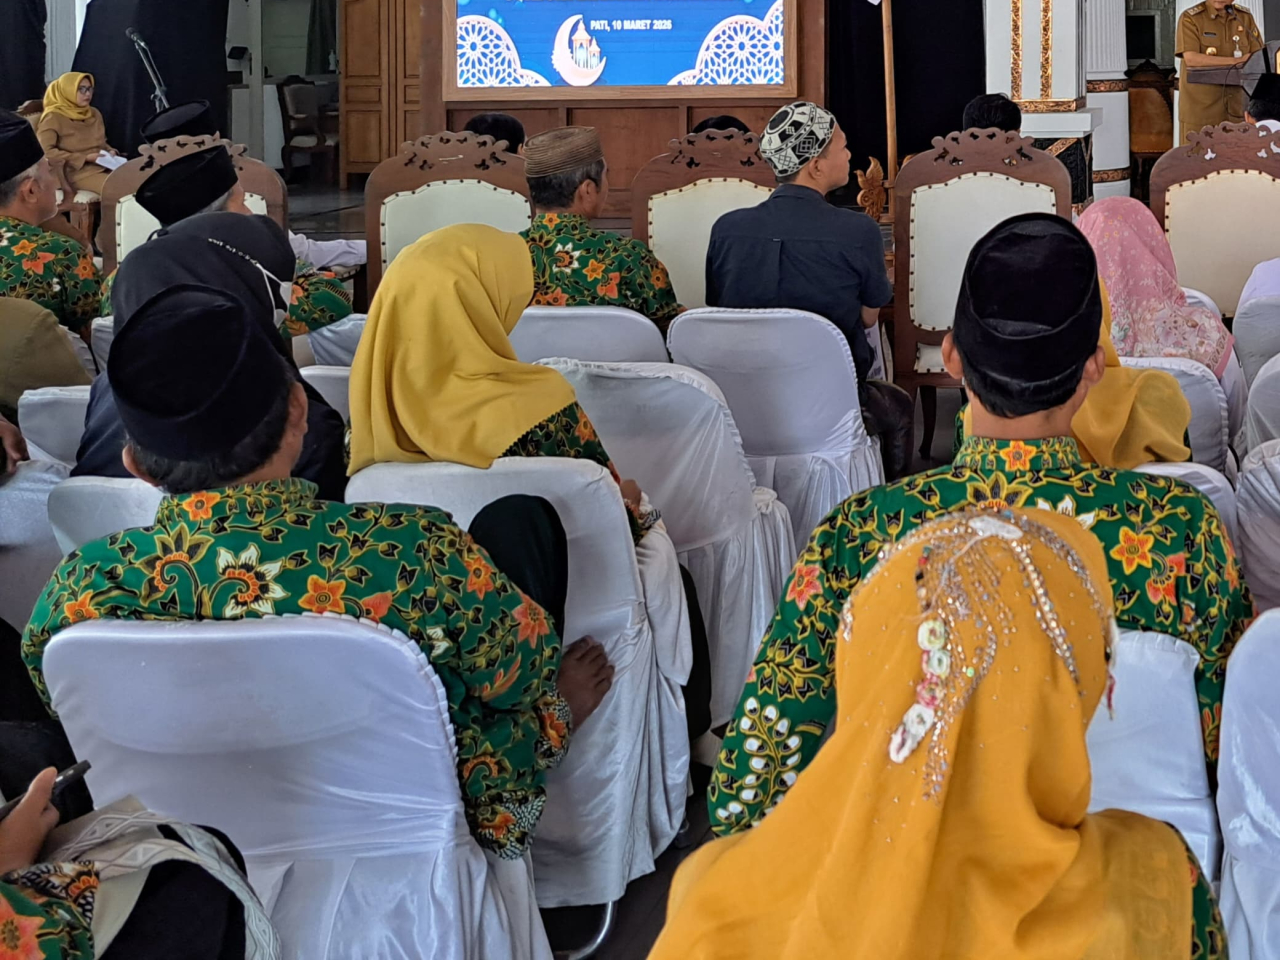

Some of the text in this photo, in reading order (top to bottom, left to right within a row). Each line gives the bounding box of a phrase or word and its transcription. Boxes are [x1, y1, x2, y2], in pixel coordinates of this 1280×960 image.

[590, 20, 611, 32] PATI,
[612, 20, 622, 30] 10
[623, 20, 651, 30] MARET
